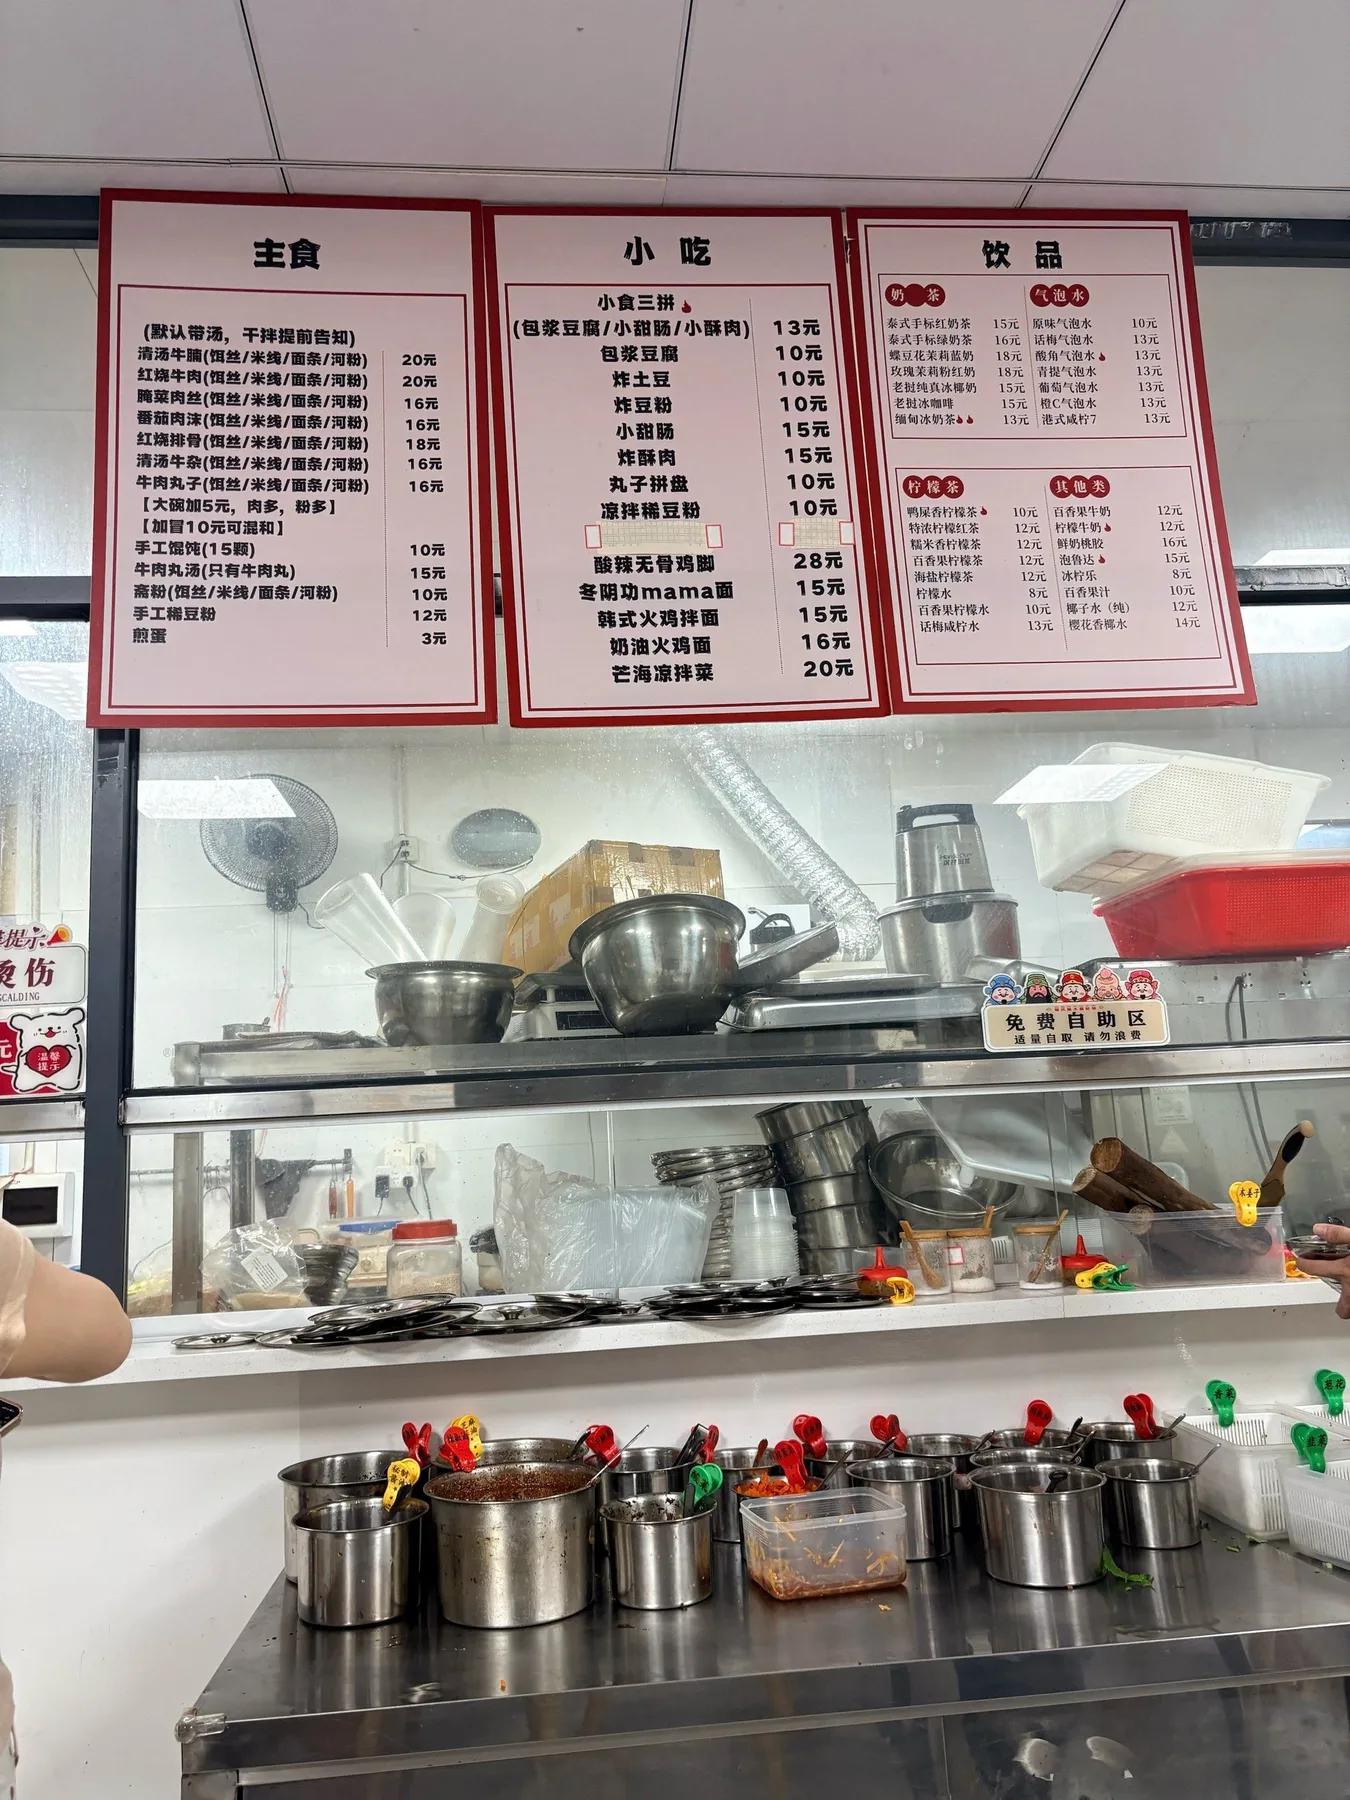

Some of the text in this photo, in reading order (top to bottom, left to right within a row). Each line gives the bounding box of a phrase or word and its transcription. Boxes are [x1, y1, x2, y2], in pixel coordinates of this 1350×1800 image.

[254, 238, 320, 270] 主食
[624, 236, 711, 266] 小吃
[982, 240, 1062, 268] 饮品
[598, 294, 674, 311] 小食三拼
[890, 288, 940, 303] 奶茶
[1034, 288, 1085, 303] 气泡水
[514, 319, 820, 339] (包浆豆腐/小甜肠/小酥肉) 13元
[888, 318, 1019, 329] 泰式手标红奶茶 15元
[1033, 318, 1157, 329] 原味气泡水 10元
[889, 334, 1020, 345] 泰式手标绿奶茶 16元
[1034, 334, 1159, 345] 话梅气泡水 13元
[138, 346, 436, 369] 清汤牛腩(饵丝/米线/面条/河粉) 20元
[601, 345, 822, 362] 包浆豆腐 10元
[996, 351, 1022, 361] 18元
[1035, 350, 1160, 361] 酸角气泡水 13元
[138, 367, 437, 390] 红烧牛肉(饵丝/米线/面条/河粉) 20元
[890, 366, 1023, 377] 玫瑰茉莉粉红奶 18元
[1038, 366, 1162, 377] 青提气泡水 13元
[612, 371, 825, 388] 炸土豆 10元
[892, 382, 1025, 393] 老挝纯真冰椰奶 15元
[1038, 382, 1164, 393] 葡萄气泡水 13元
[137, 389, 438, 411] 腌菜肉丝(饵丝/米线/面条/河粉) 16元
[614, 396, 827, 414] 炸豆粉 10元
[893, 398, 1027, 409] 老挝冰咖啡 15元
[1040, 398, 1166, 409] 橙C气泡水 13元
[137, 410, 439, 432] 番茄肉沫(饵丝/米线/面条/河粉) 16元
[894, 414, 1029, 425] 缅甸冰奶茶 13元
[1041, 414, 1170, 425] 港式咸柠7 13元
[616, 421, 830, 440] 小甜肠 15元
[137, 432, 440, 453] 红烧排骨(饵丝/米线/面条/河粉) 18元
[137, 453, 442, 474] 清汤牛杂(饵丝/米线/面条/河粉) 16元
[617, 447, 832, 466] 炸酥肉 15元
[136, 475, 443, 495] 牛肉丸子(饵丝/米线/面条/河粉) 16元
[609, 473, 835, 493] 丸子拼盘 10元
[907, 479, 959, 494] 柠檬茶
[1053, 479, 1106, 493] 其他类
[601, 499, 837, 520] 凉拌稀豆粉 10元
[1013, 508, 1038, 517] 10元
[1054, 506, 1182, 517] 百香果牛奶 12元
[908, 523, 1040, 534] 特浓柠檬红茶 12元
[1055, 521, 1185, 533] 柠檬牛奶 12元
[135, 540, 445, 559] 手工馄饨(15颗) 10元
[910, 539, 1042, 550] 糯米香柠檬茶 12元
[1056, 538, 1187, 549] 鲜奶桃胶 16元
[594, 552, 842, 574] 酸辣无骨鸡脚 28元
[913, 555, 1044, 566] 百香果柠檬茶 12元
[1059, 553, 1190, 565] 泡鲁达 15元
[135, 562, 445, 580] 牛肉丸汤(只有牛肉丸) 15元
[913, 571, 1046, 583] 海盐柠檬茶 12元
[1061, 569, 1191, 581] 冰柠乐 8元
[134, 584, 447, 602] 斋粉(饵丝/米线/面条/河粉) 10元
[579, 580, 845, 601] 冬阴功mama面 15元
[916, 588, 1048, 599] 柠檬水 8元
[1065, 585, 1195, 598] 百香果汁 10元
[133, 606, 446, 621] 手工稀豆粉 12元
[919, 604, 1051, 616] 百香果柠檬水 10元
[1172, 601, 1197, 611] 12元
[598, 607, 847, 628] 韩式火鸡拌面 15元
[1175, 617, 1200, 627] 14元
[920, 621, 1053, 632] 话梅咸柠水 13元
[133, 628, 446, 645] 煎蛋 3元
[610, 632, 850, 656] 奶油火鸡面 16元
[612, 661, 853, 683] 芒海凉拌菜 20元
[0, 928, 46, 950] 提示
[1006, 1009, 1147, 1032] 免费自助区
[1015, 1030, 1142, 1045] 适量自取 请勿浪费
[1214, 1388, 1235, 1399] 香菜
[1307, 1434, 1328, 1447] 韭菜
